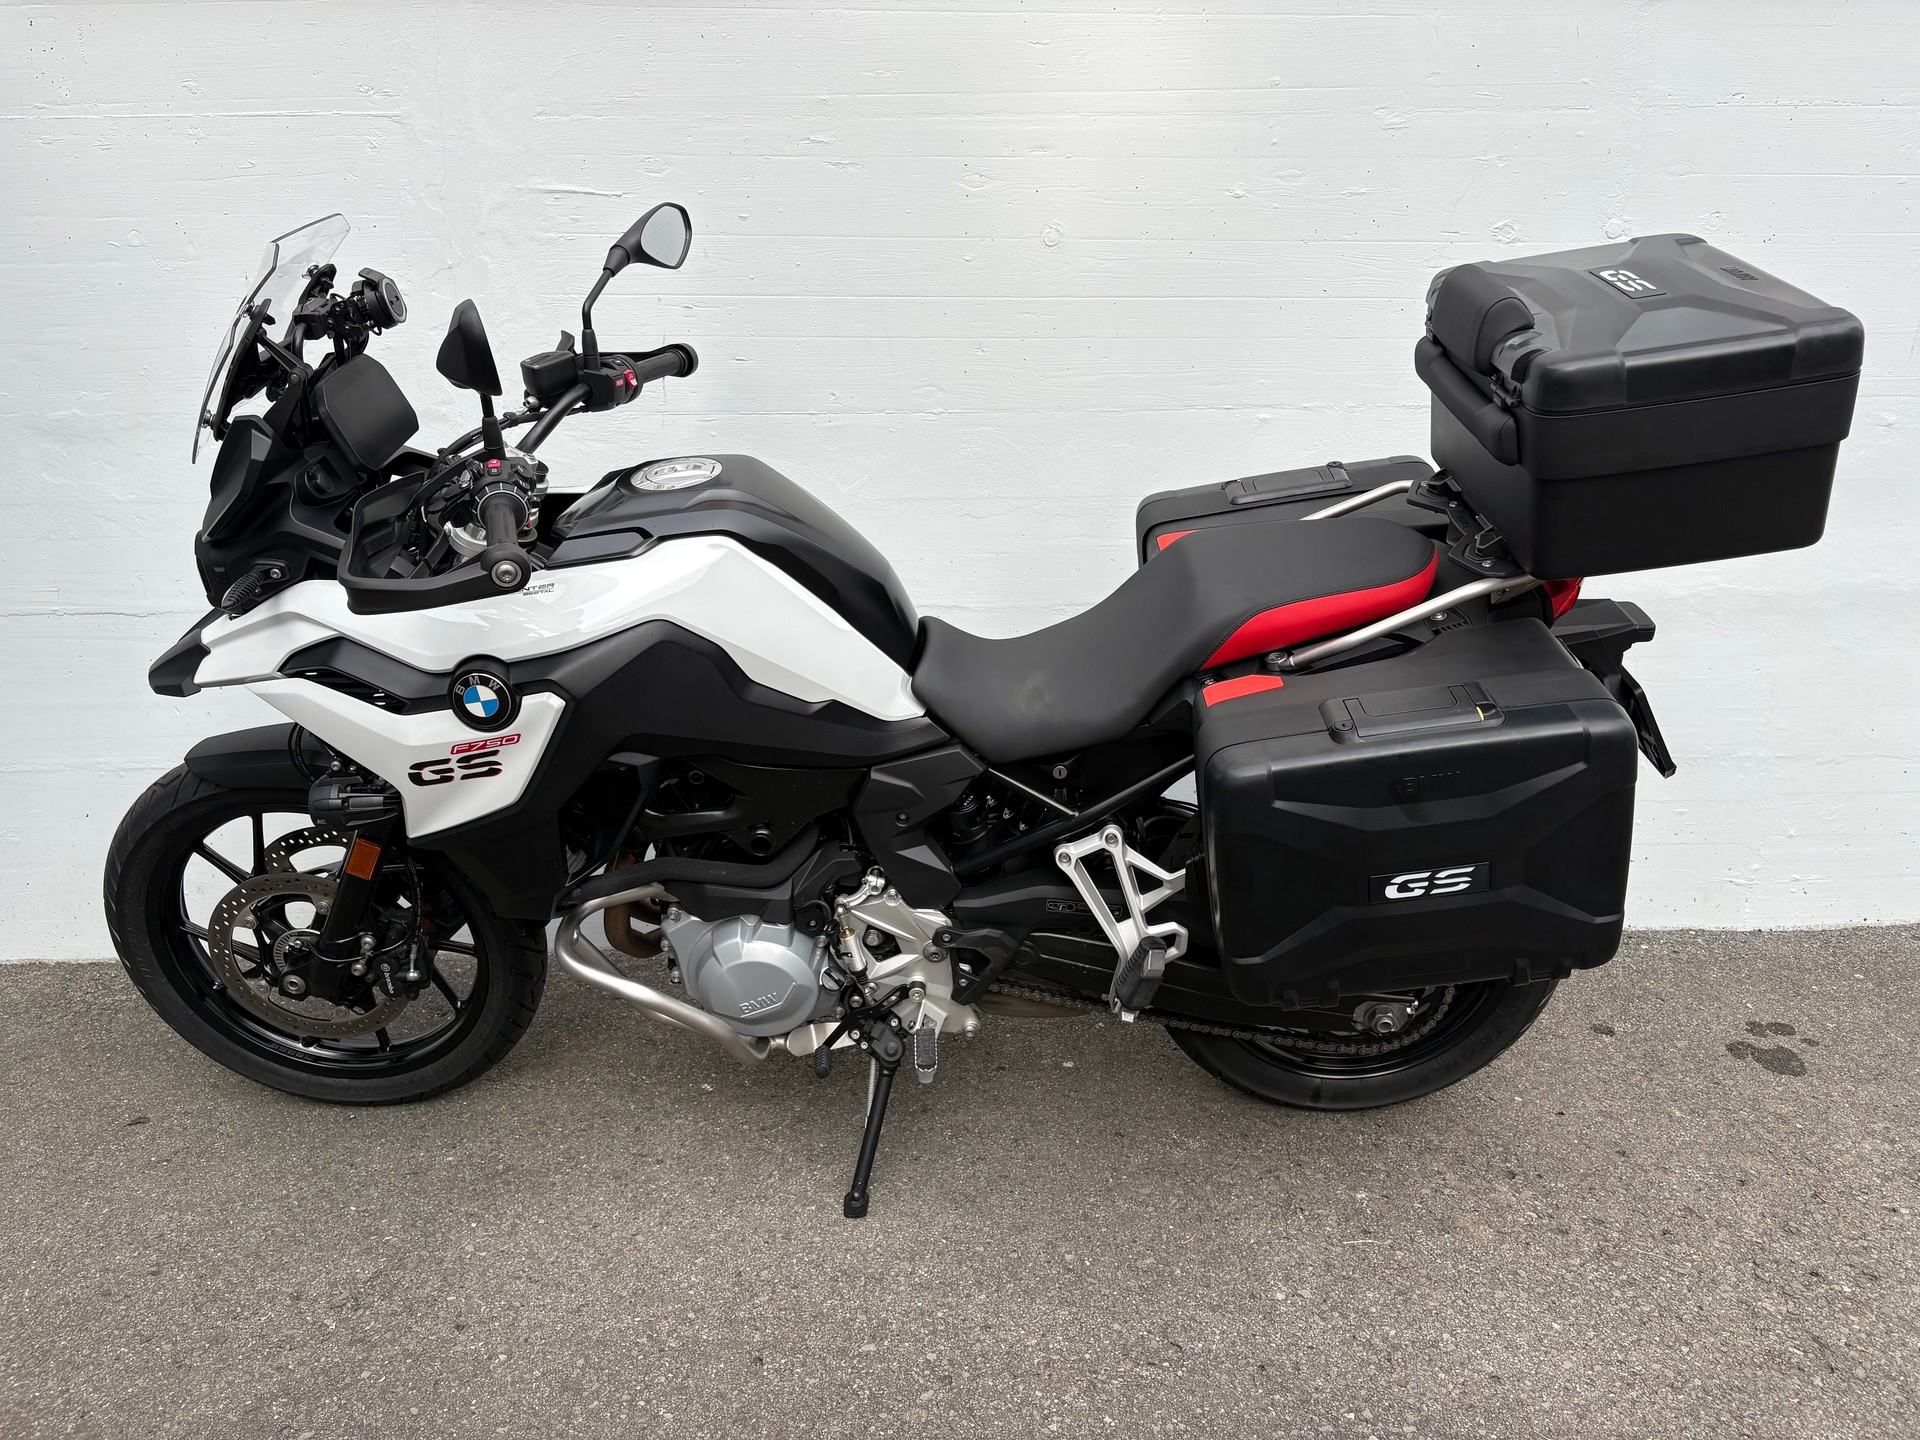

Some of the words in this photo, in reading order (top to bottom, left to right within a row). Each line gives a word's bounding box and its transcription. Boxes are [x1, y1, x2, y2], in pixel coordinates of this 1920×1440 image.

[1599, 269, 1657, 292] GS
[521, 583, 555, 593] NTER
[455, 675, 501, 695] BMW
[453, 734, 519, 754] F750
[408, 750, 503, 787] GS
[1384, 866, 1476, 899] GS
[739, 992, 777, 1014] BMW
